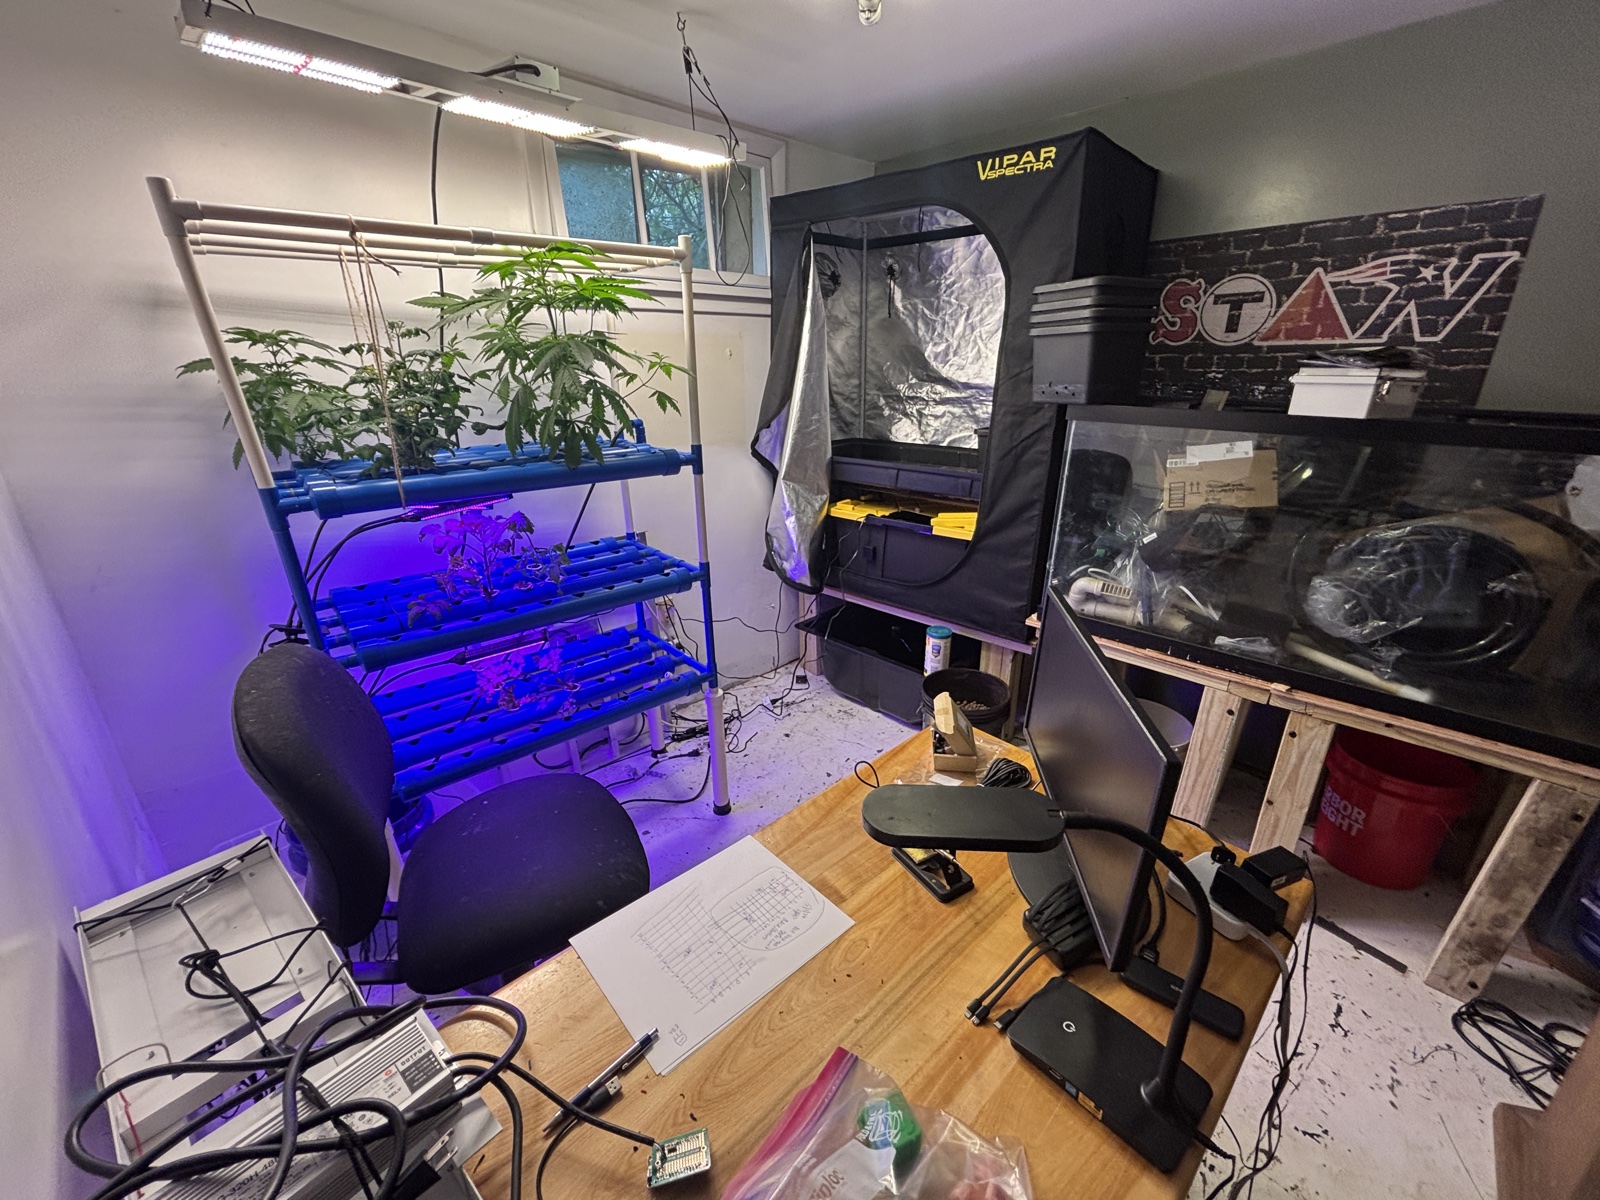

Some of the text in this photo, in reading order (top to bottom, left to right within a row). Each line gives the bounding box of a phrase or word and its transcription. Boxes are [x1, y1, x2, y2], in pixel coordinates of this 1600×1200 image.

[976, 146, 1057, 181] VIPAR
[986, 159, 1054, 180] SPECTRA
[400, 1046, 426, 1066] OUTPUT
[809, 1169, 845, 1200] iploc
